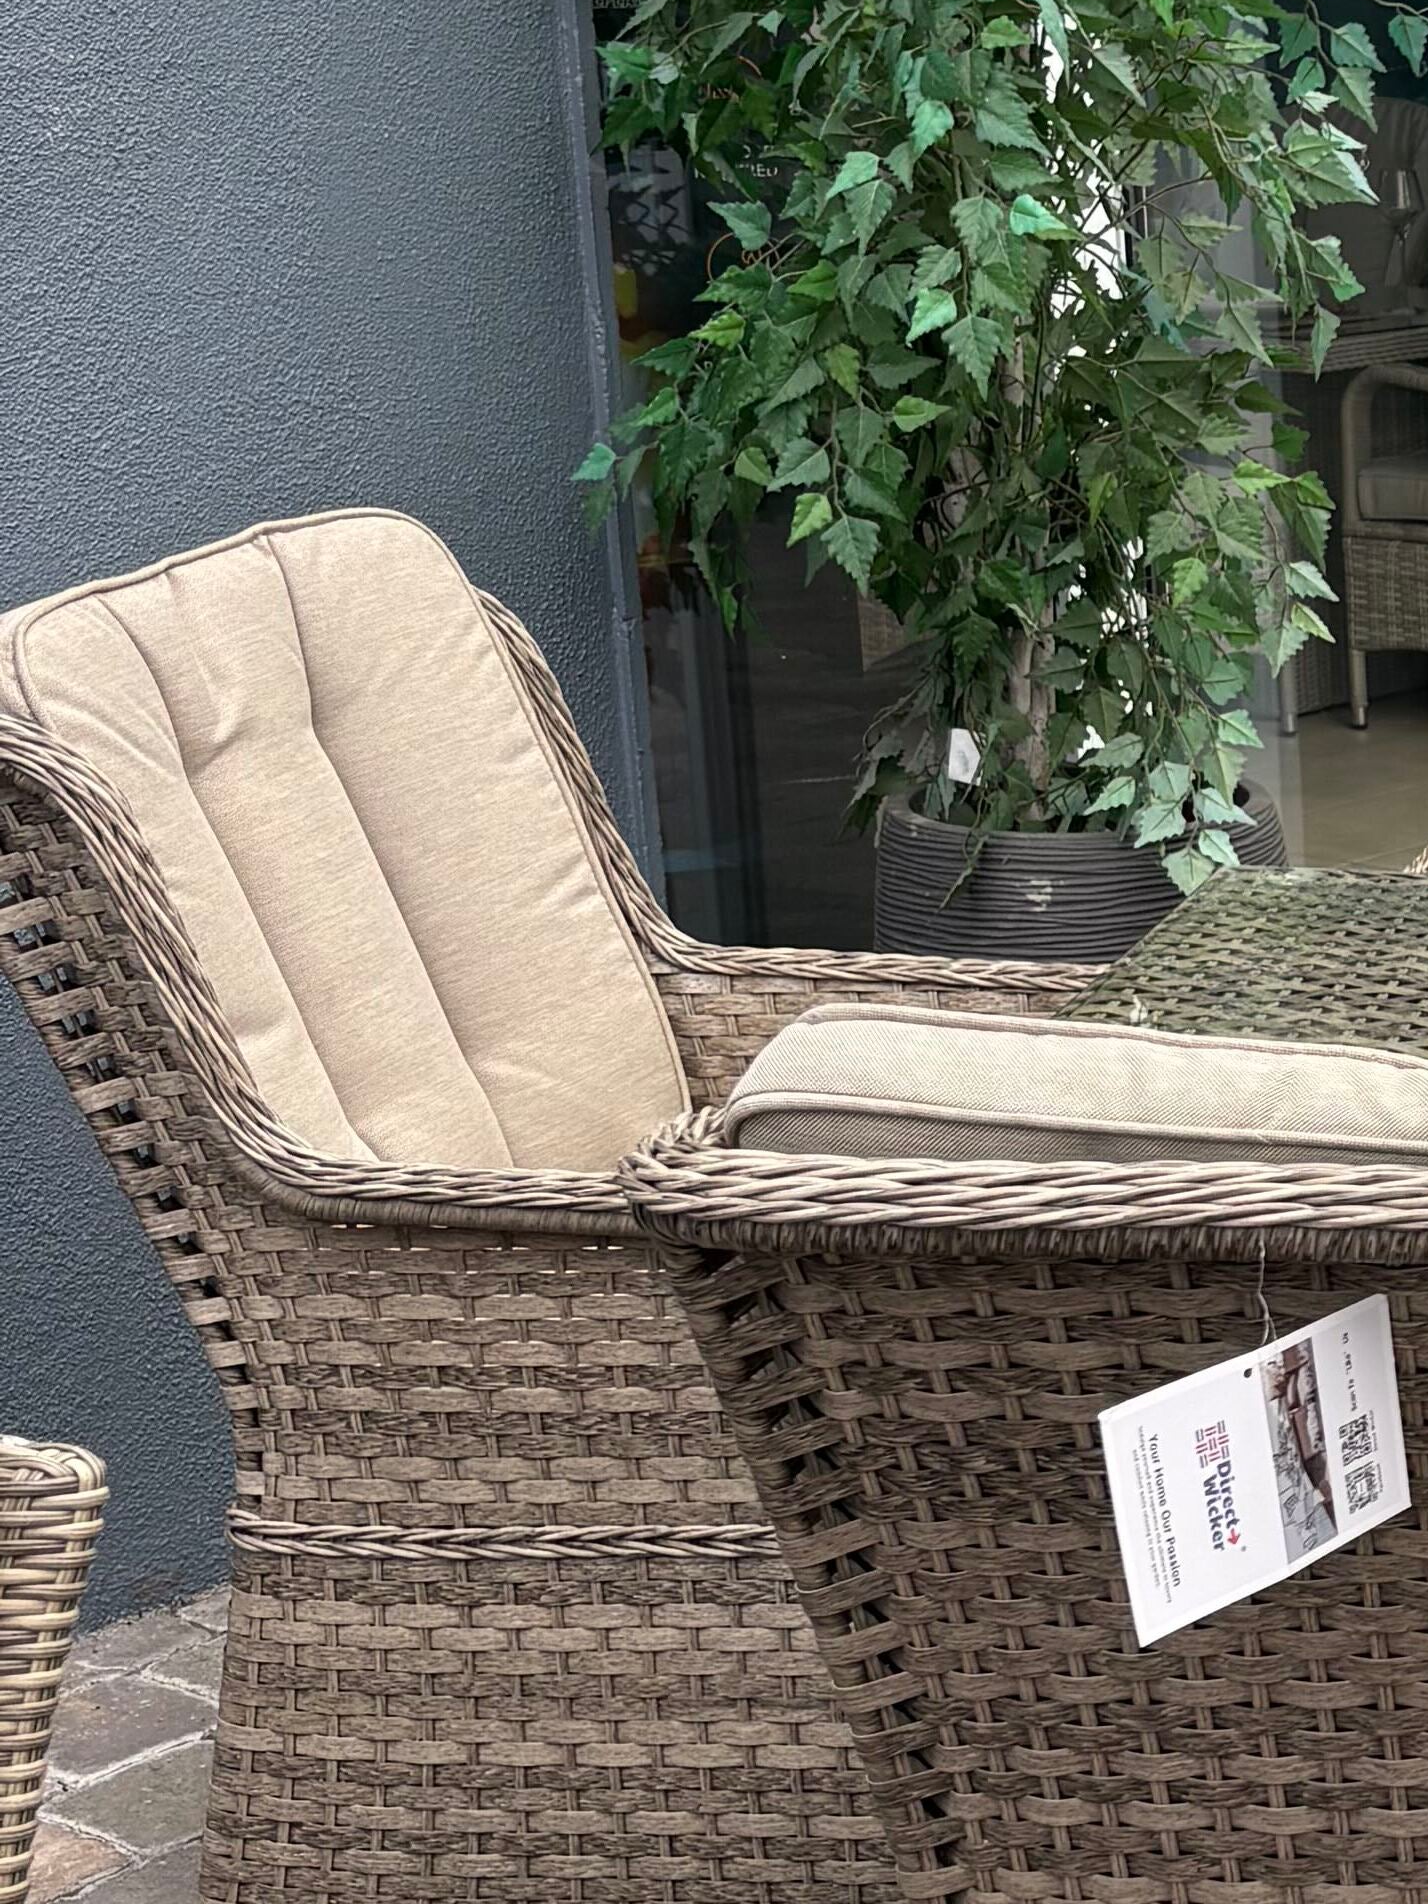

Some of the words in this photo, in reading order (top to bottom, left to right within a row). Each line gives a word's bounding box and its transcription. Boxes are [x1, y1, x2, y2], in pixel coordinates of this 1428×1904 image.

[1148, 1433, 1162, 1464] Your
[1154, 1467, 1168, 1507] Home
[1216, 1459, 1240, 1530] Direct
[1161, 1509, 1173, 1534] Our
[1203, 1473, 1226, 1552] Wicker
[1166, 1536, 1182, 1587] Passion
